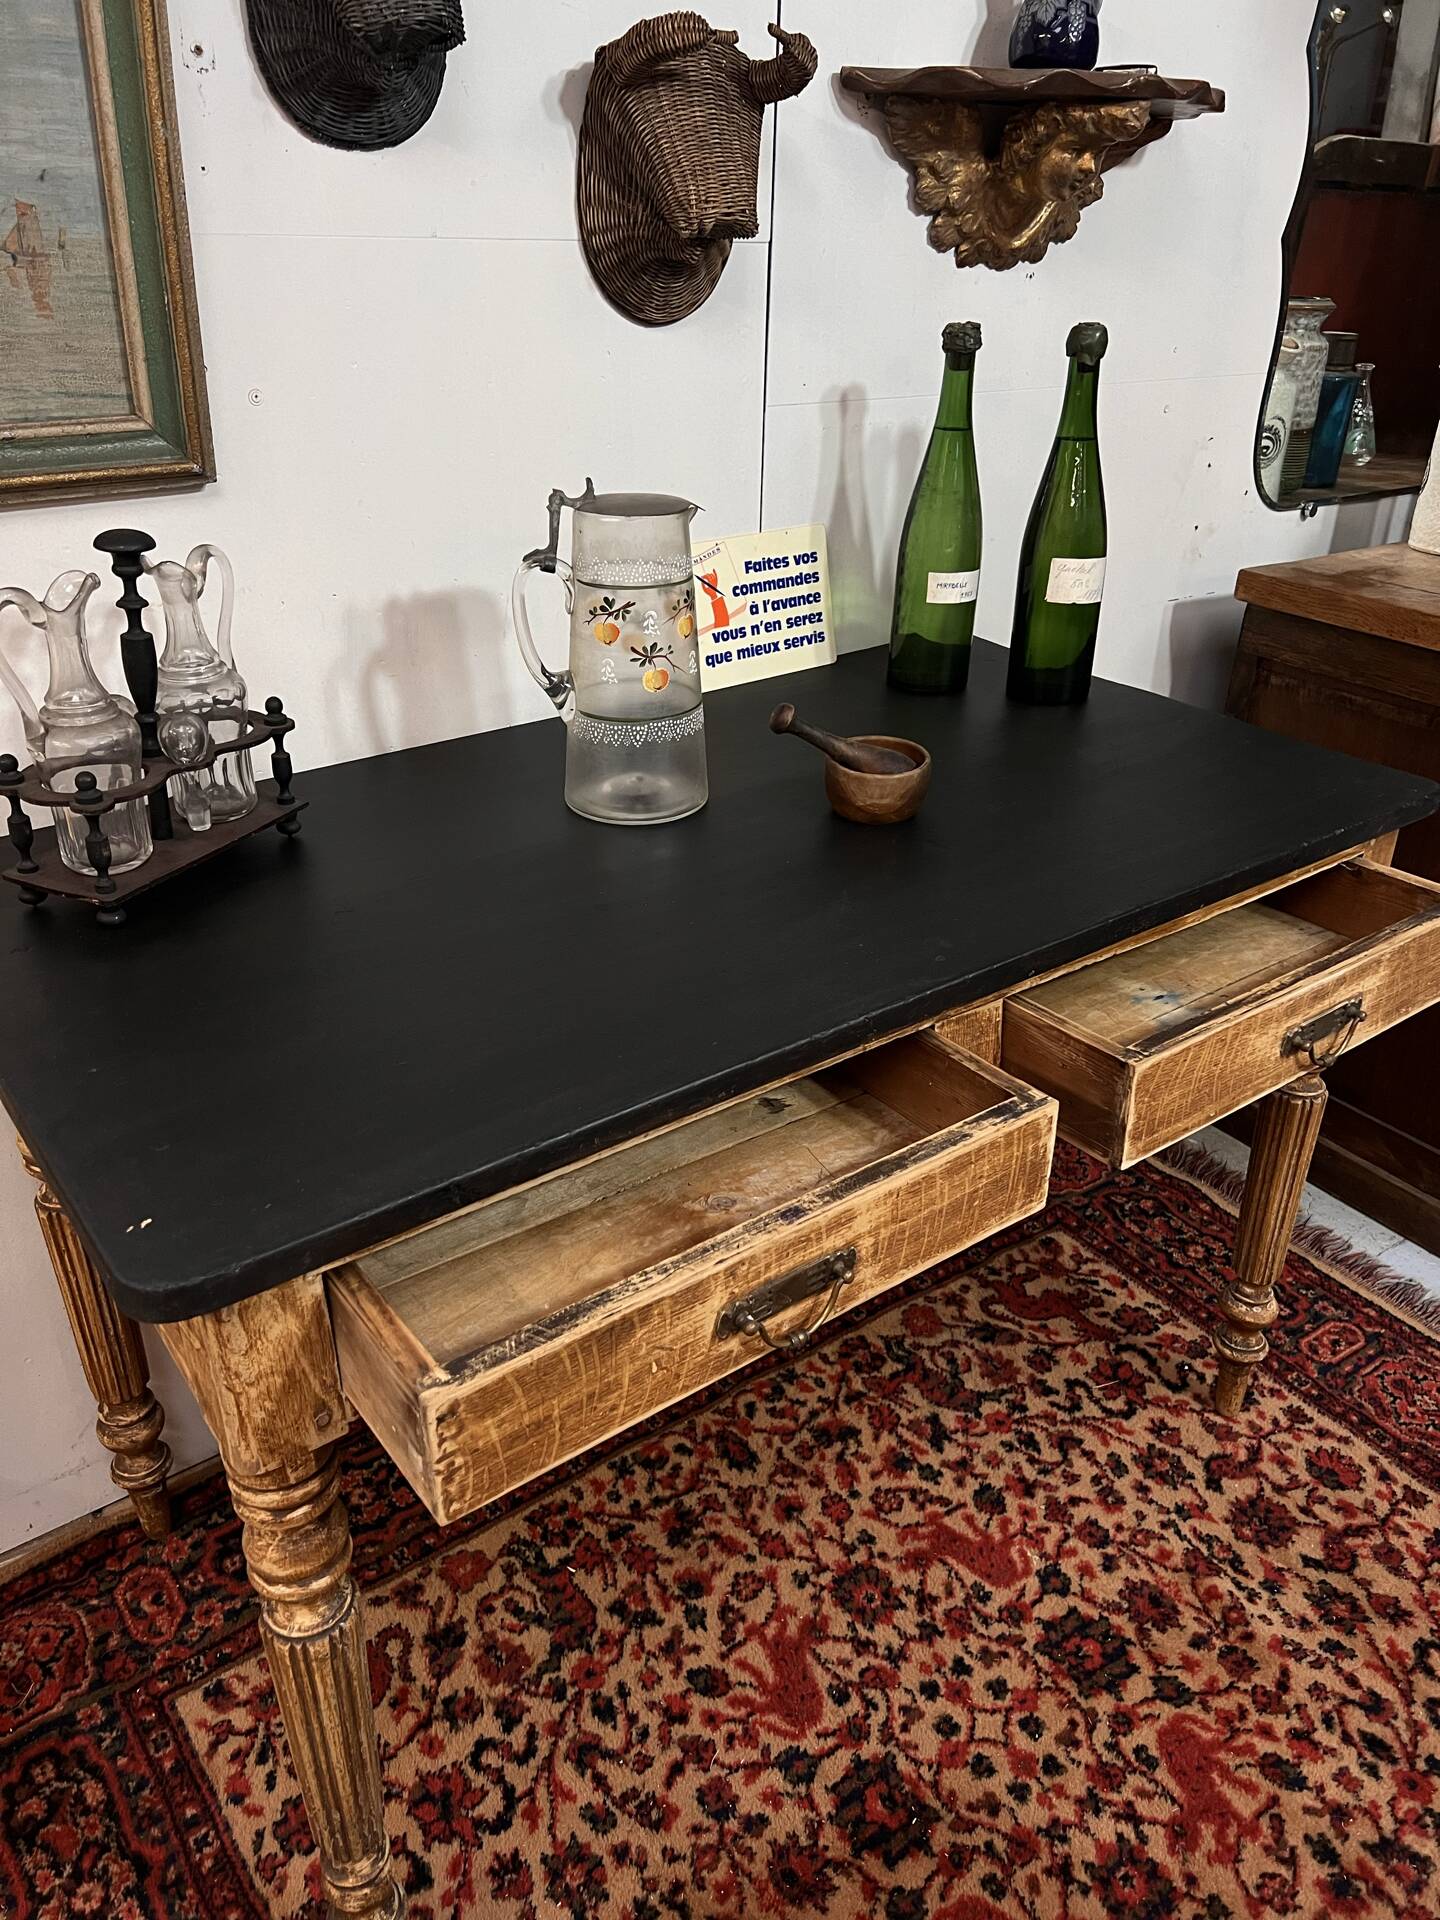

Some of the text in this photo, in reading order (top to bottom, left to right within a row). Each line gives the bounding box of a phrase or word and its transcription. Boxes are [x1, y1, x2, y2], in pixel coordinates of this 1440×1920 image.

[744, 551, 818, 574] Faites vos
[732, 571, 820, 597] commandes
[749, 591, 821, 616] à l'avance
[712, 611, 823, 644] vous n'en serez
[705, 631, 826, 668] que mieux servis
